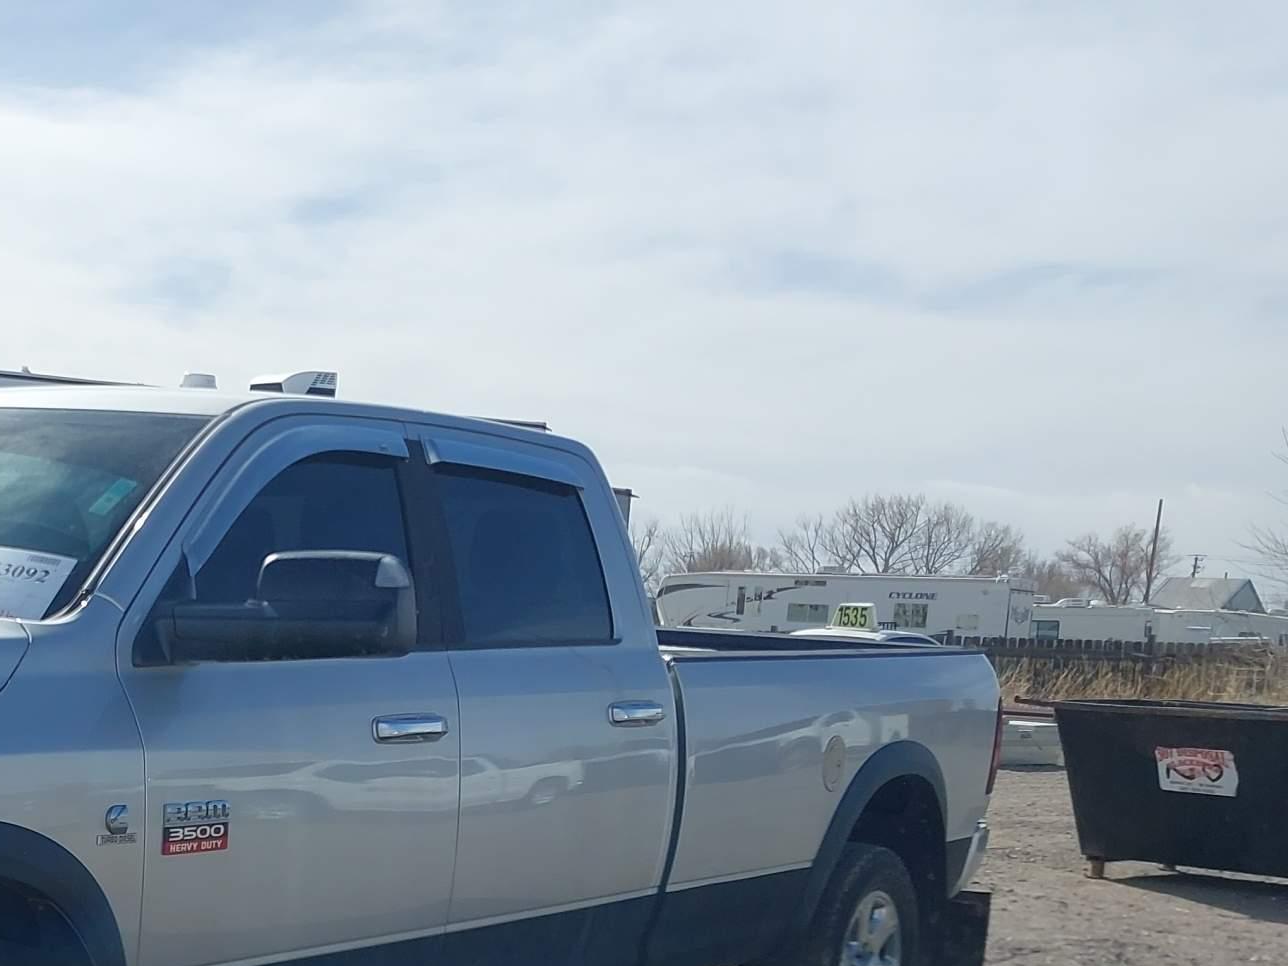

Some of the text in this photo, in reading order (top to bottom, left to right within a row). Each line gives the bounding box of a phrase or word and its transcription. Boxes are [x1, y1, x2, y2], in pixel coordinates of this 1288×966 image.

[888, 591, 937, 600] CYCLONE
[837, 606, 868, 628] 1535
[164, 800, 230, 823] RAM
[168, 824, 224, 842] 3500
[170, 840, 223, 853] HEAVY DUTY
